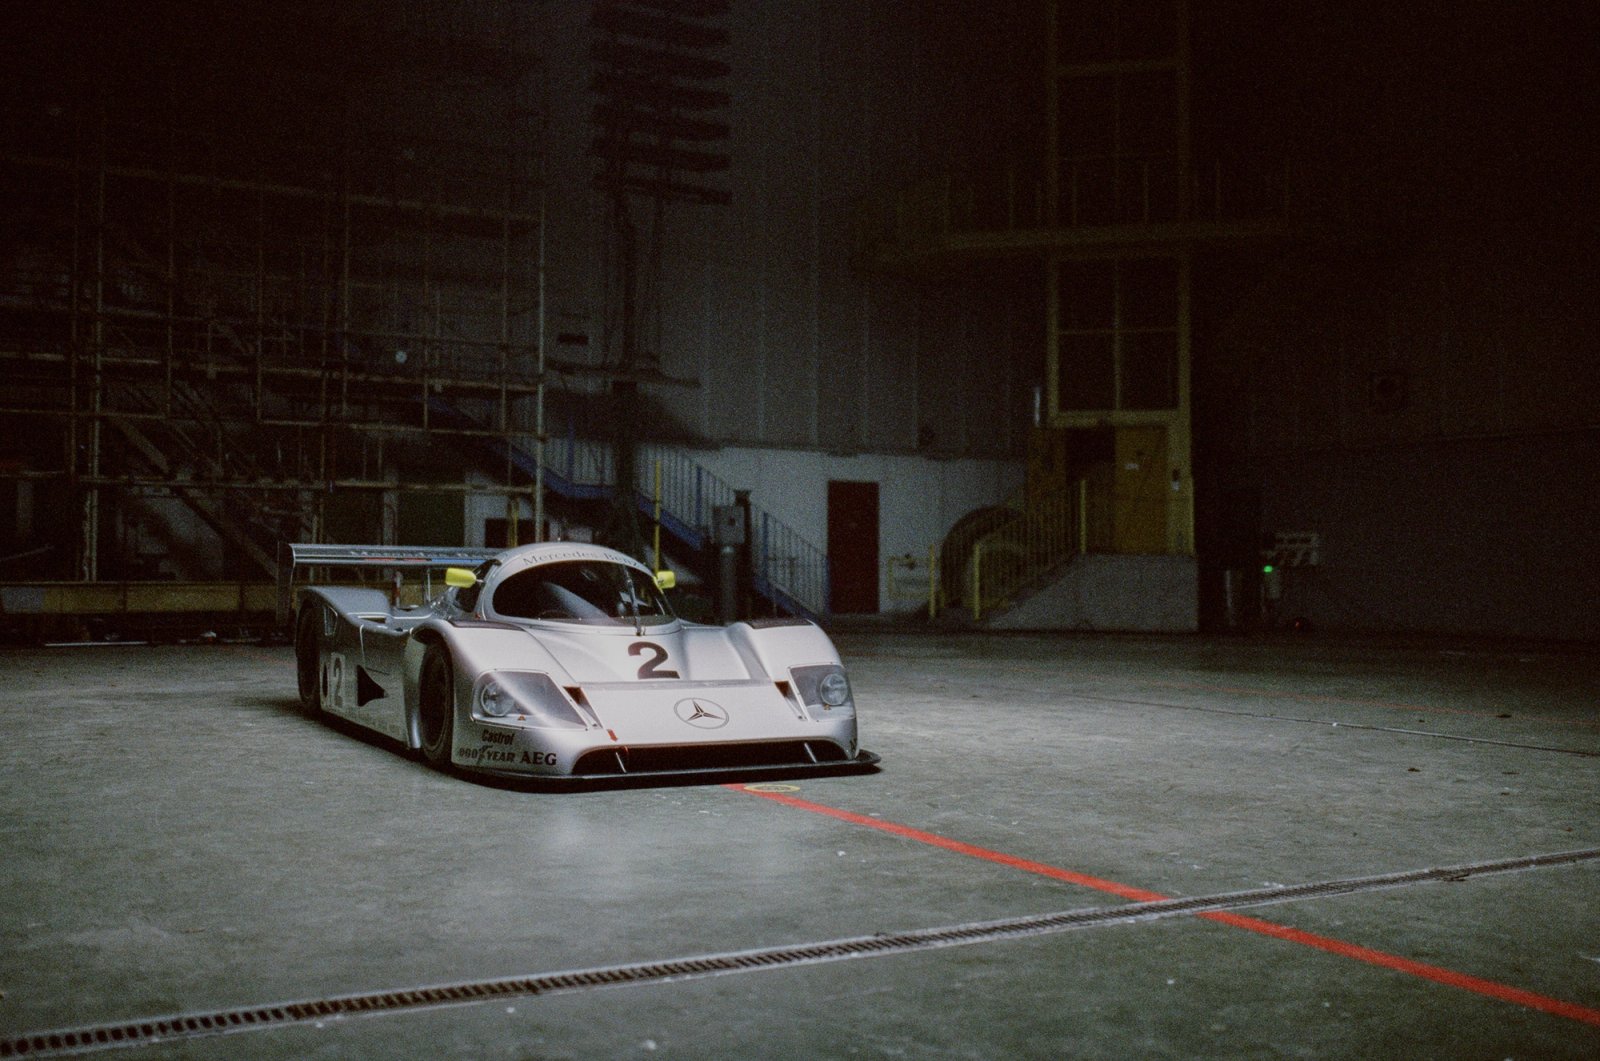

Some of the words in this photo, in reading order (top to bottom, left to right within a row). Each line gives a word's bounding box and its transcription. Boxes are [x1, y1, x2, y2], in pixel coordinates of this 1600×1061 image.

[627, 641, 680, 680] 2
[482, 729, 515, 745] Castrol
[520, 751, 557, 766] AEG
